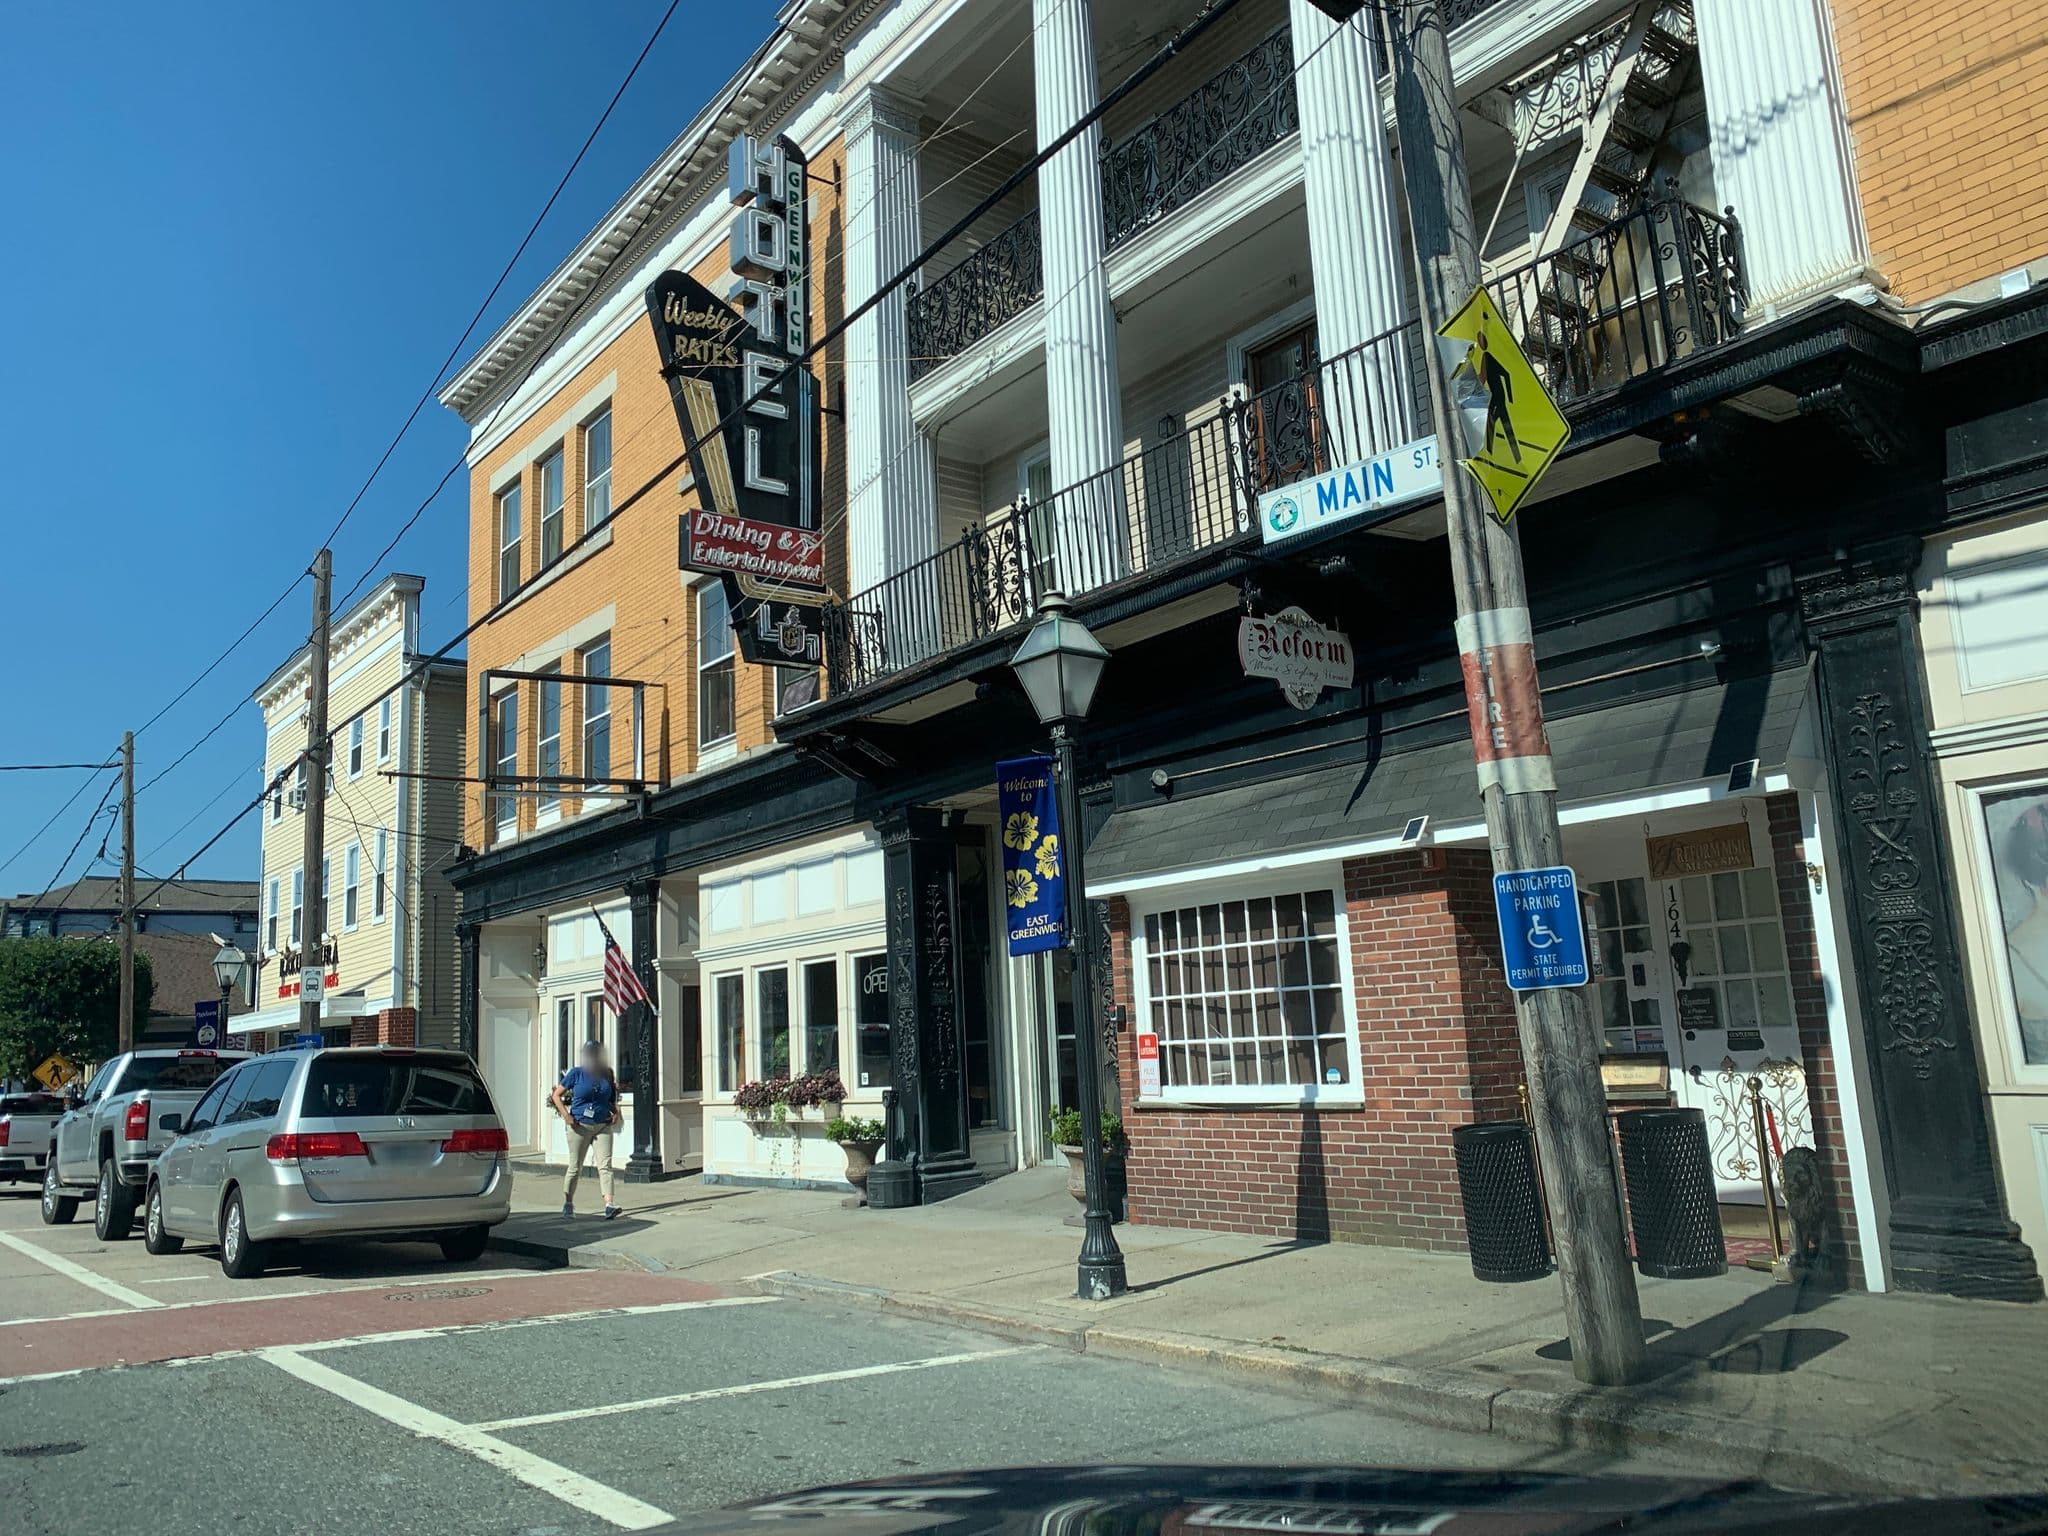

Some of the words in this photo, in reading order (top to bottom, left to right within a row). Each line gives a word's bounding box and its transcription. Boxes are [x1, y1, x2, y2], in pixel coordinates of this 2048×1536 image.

[787, 169, 804, 347] GREENWICH
[663, 290, 736, 342] Weekly
[745, 134, 789, 496] HOTEL
[674, 334, 738, 369] RATES
[1316, 458, 1395, 516] MAIN
[1413, 446, 1432, 469] ST
[693, 512, 772, 552] Dining
[777, 530, 795, 551] &
[692, 540, 823, 582] Entertainment
[1253, 621, 1348, 665] Reform
[1478, 651, 1508, 749] FIRE
[1004, 777, 1049, 793] Welcome
[1020, 792, 1032, 802] to
[1498, 873, 1571, 894] HANDICAPPED
[1026, 914, 1050, 928] EAST
[1514, 894, 1561, 912] PARKING
[1666, 884, 1682, 938] 164
[1010, 921, 1063, 941] GREENWICH
[1511, 968, 1541, 980] PERMIT
[1543, 964, 1584, 978] REQUIRED
[1533, 953, 1558, 966] STATE
